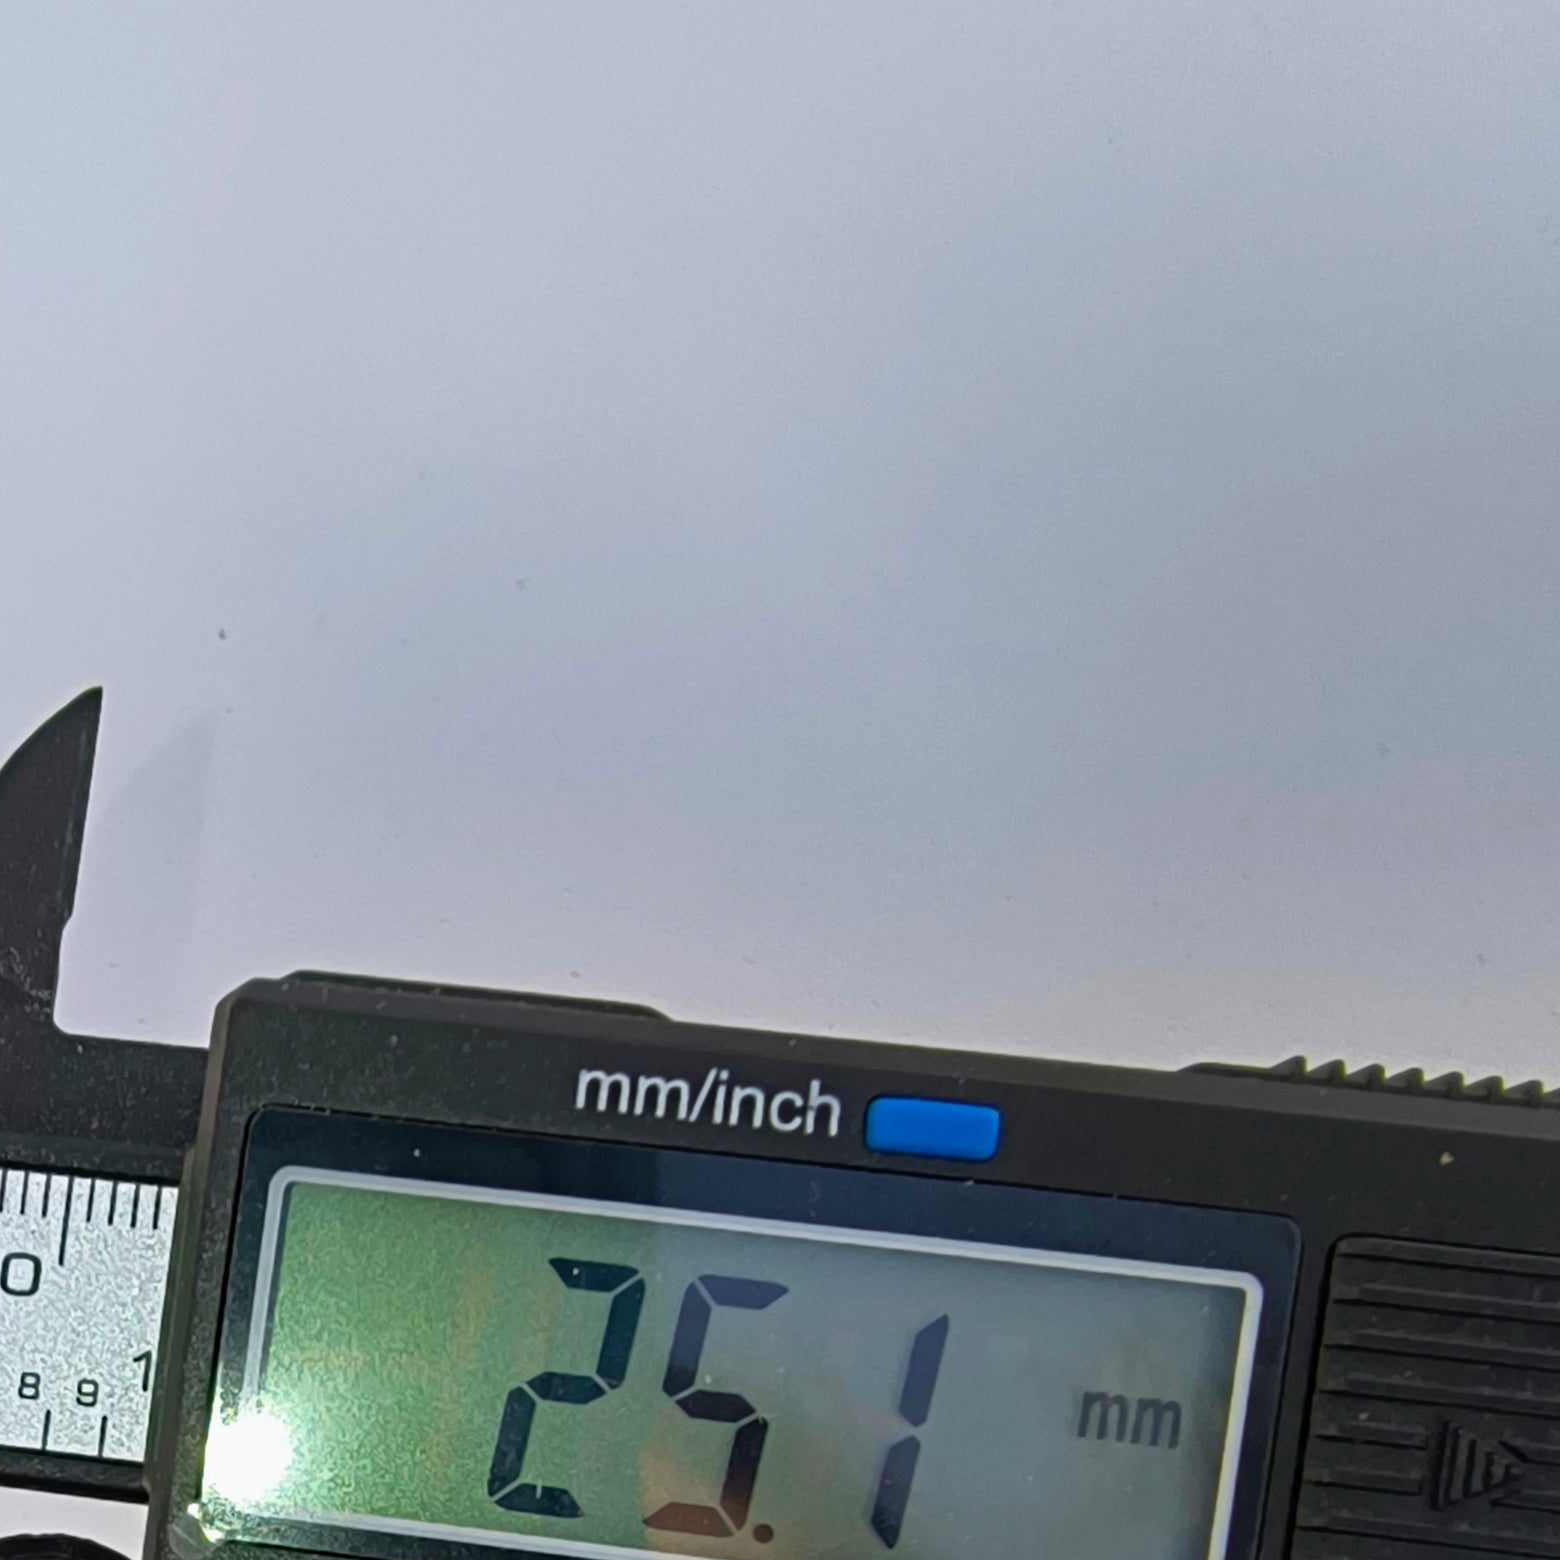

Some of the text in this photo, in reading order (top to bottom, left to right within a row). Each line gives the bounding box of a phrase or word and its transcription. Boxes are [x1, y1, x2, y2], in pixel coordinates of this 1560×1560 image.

[575, 1066, 842, 1136] mm/inch
[18, 1372, 40, 1401] 8
[75, 1378, 100, 1408] 9
[1077, 1388, 1183, 1450] mm
